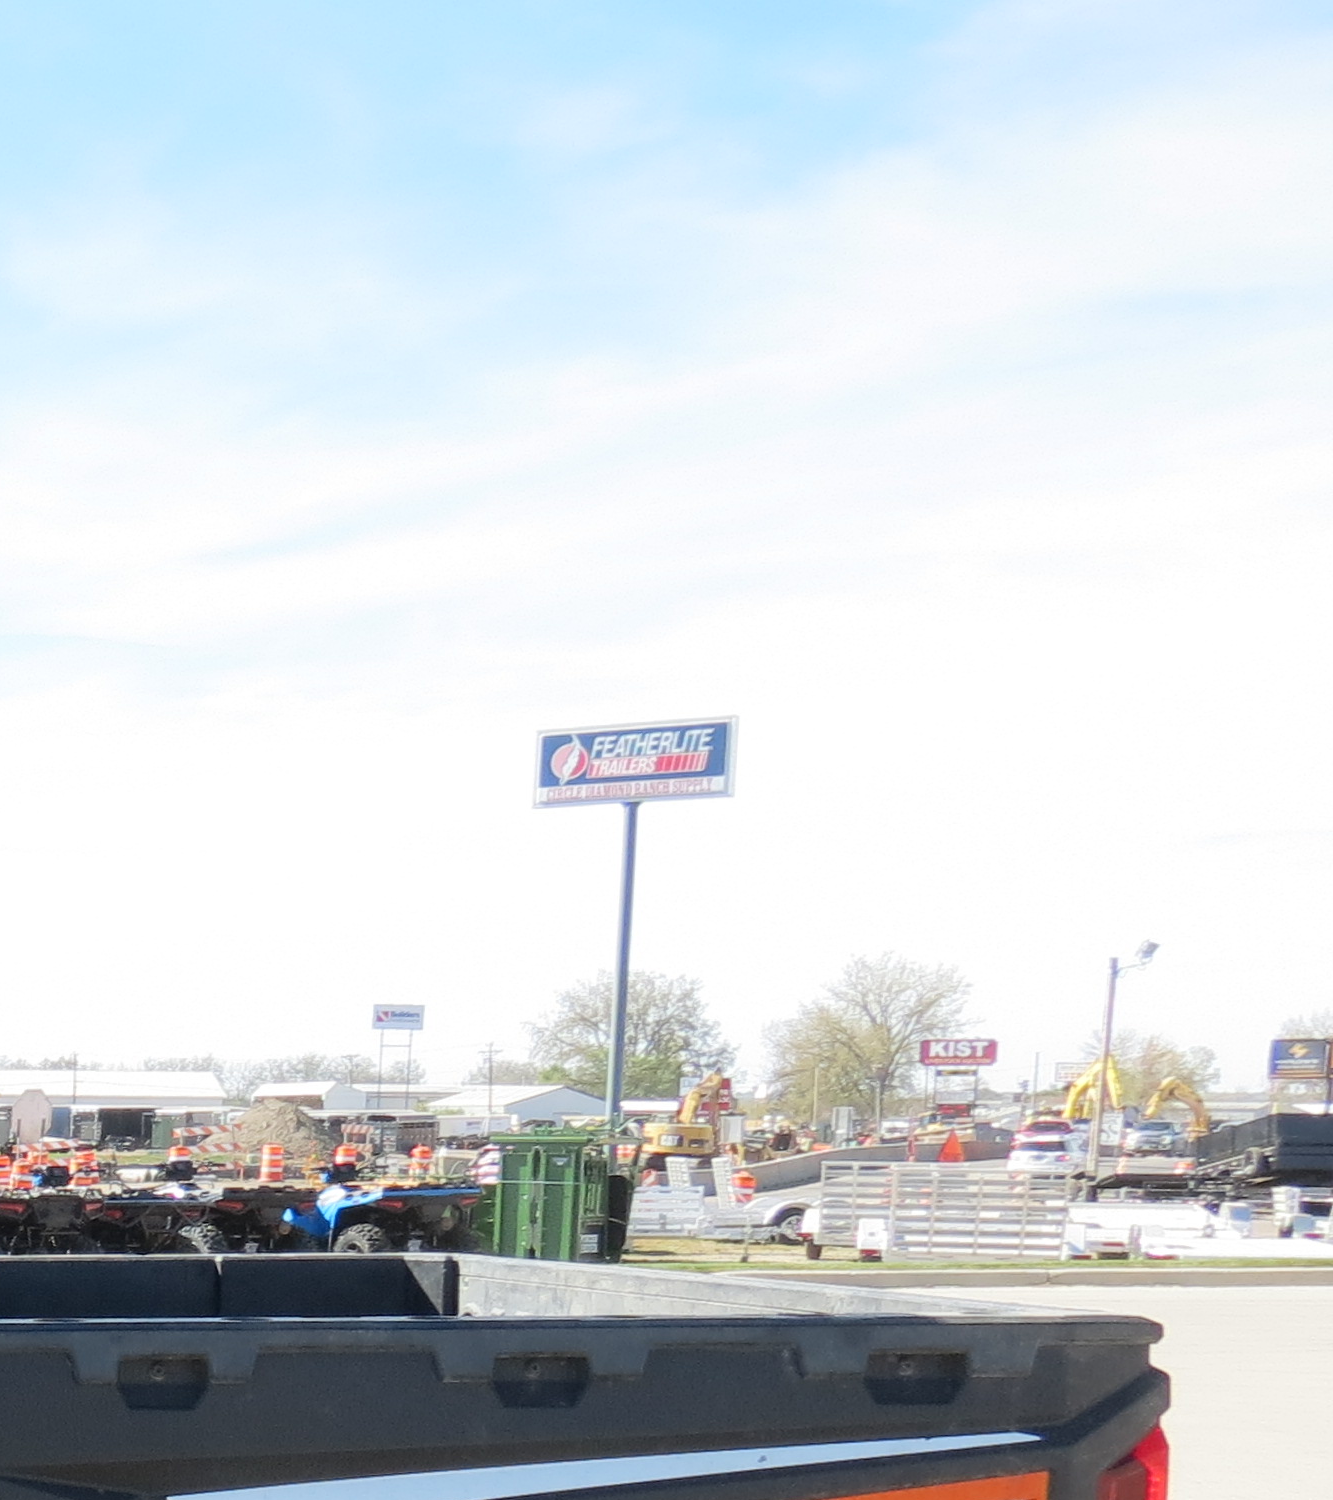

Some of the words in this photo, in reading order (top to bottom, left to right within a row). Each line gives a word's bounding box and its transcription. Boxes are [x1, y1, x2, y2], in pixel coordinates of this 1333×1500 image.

[591, 728, 715, 759] FEATHERLITE
[591, 756, 658, 777] TRAILERS
[546, 785, 584, 801] CIRCLE
[585, 782, 632, 799] DIAMOND
[635, 780, 670, 796] RANCH
[673, 778, 712, 794] SUPPLY
[928, 1041, 989, 1058] KIST
